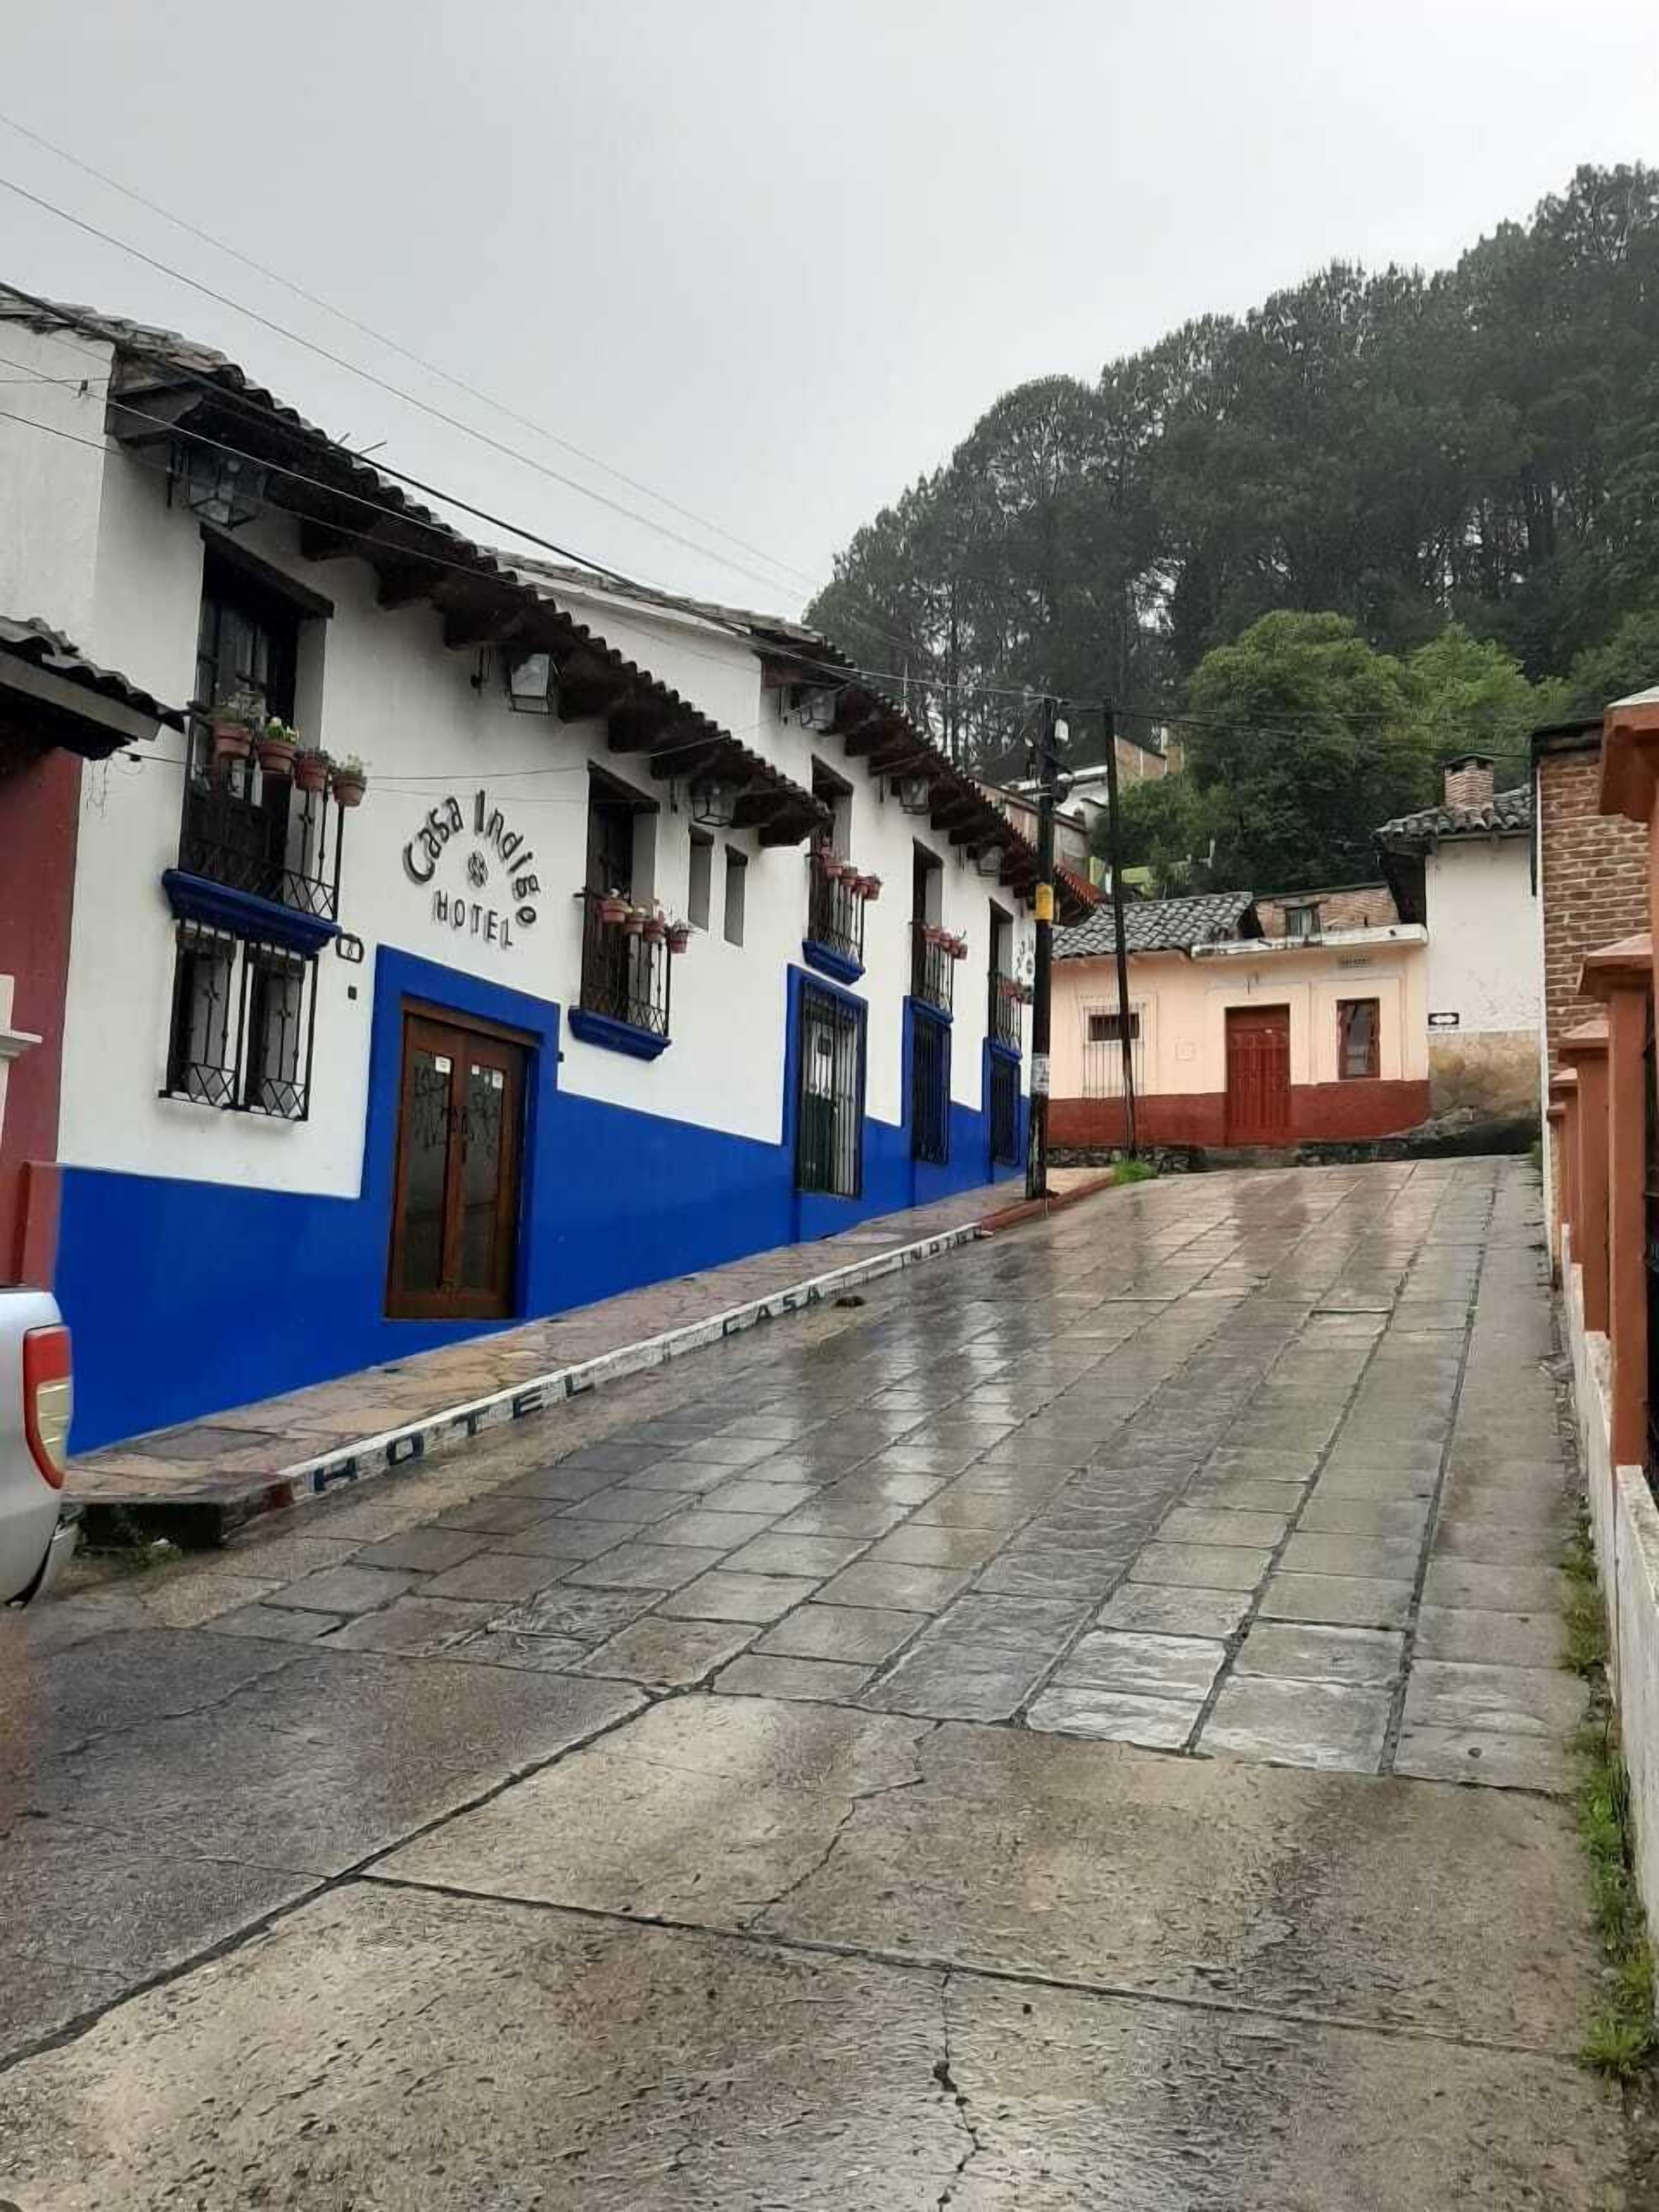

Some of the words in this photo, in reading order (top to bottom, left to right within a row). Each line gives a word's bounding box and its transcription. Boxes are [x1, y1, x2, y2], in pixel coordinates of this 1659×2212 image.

[403, 797, 463, 883] Casa
[475, 790, 540, 925] Indigo
[434, 890, 512, 948] HOTEL
[313, 1375, 595, 1492] HOTEL
[722, 1285, 821, 1337] CASA
